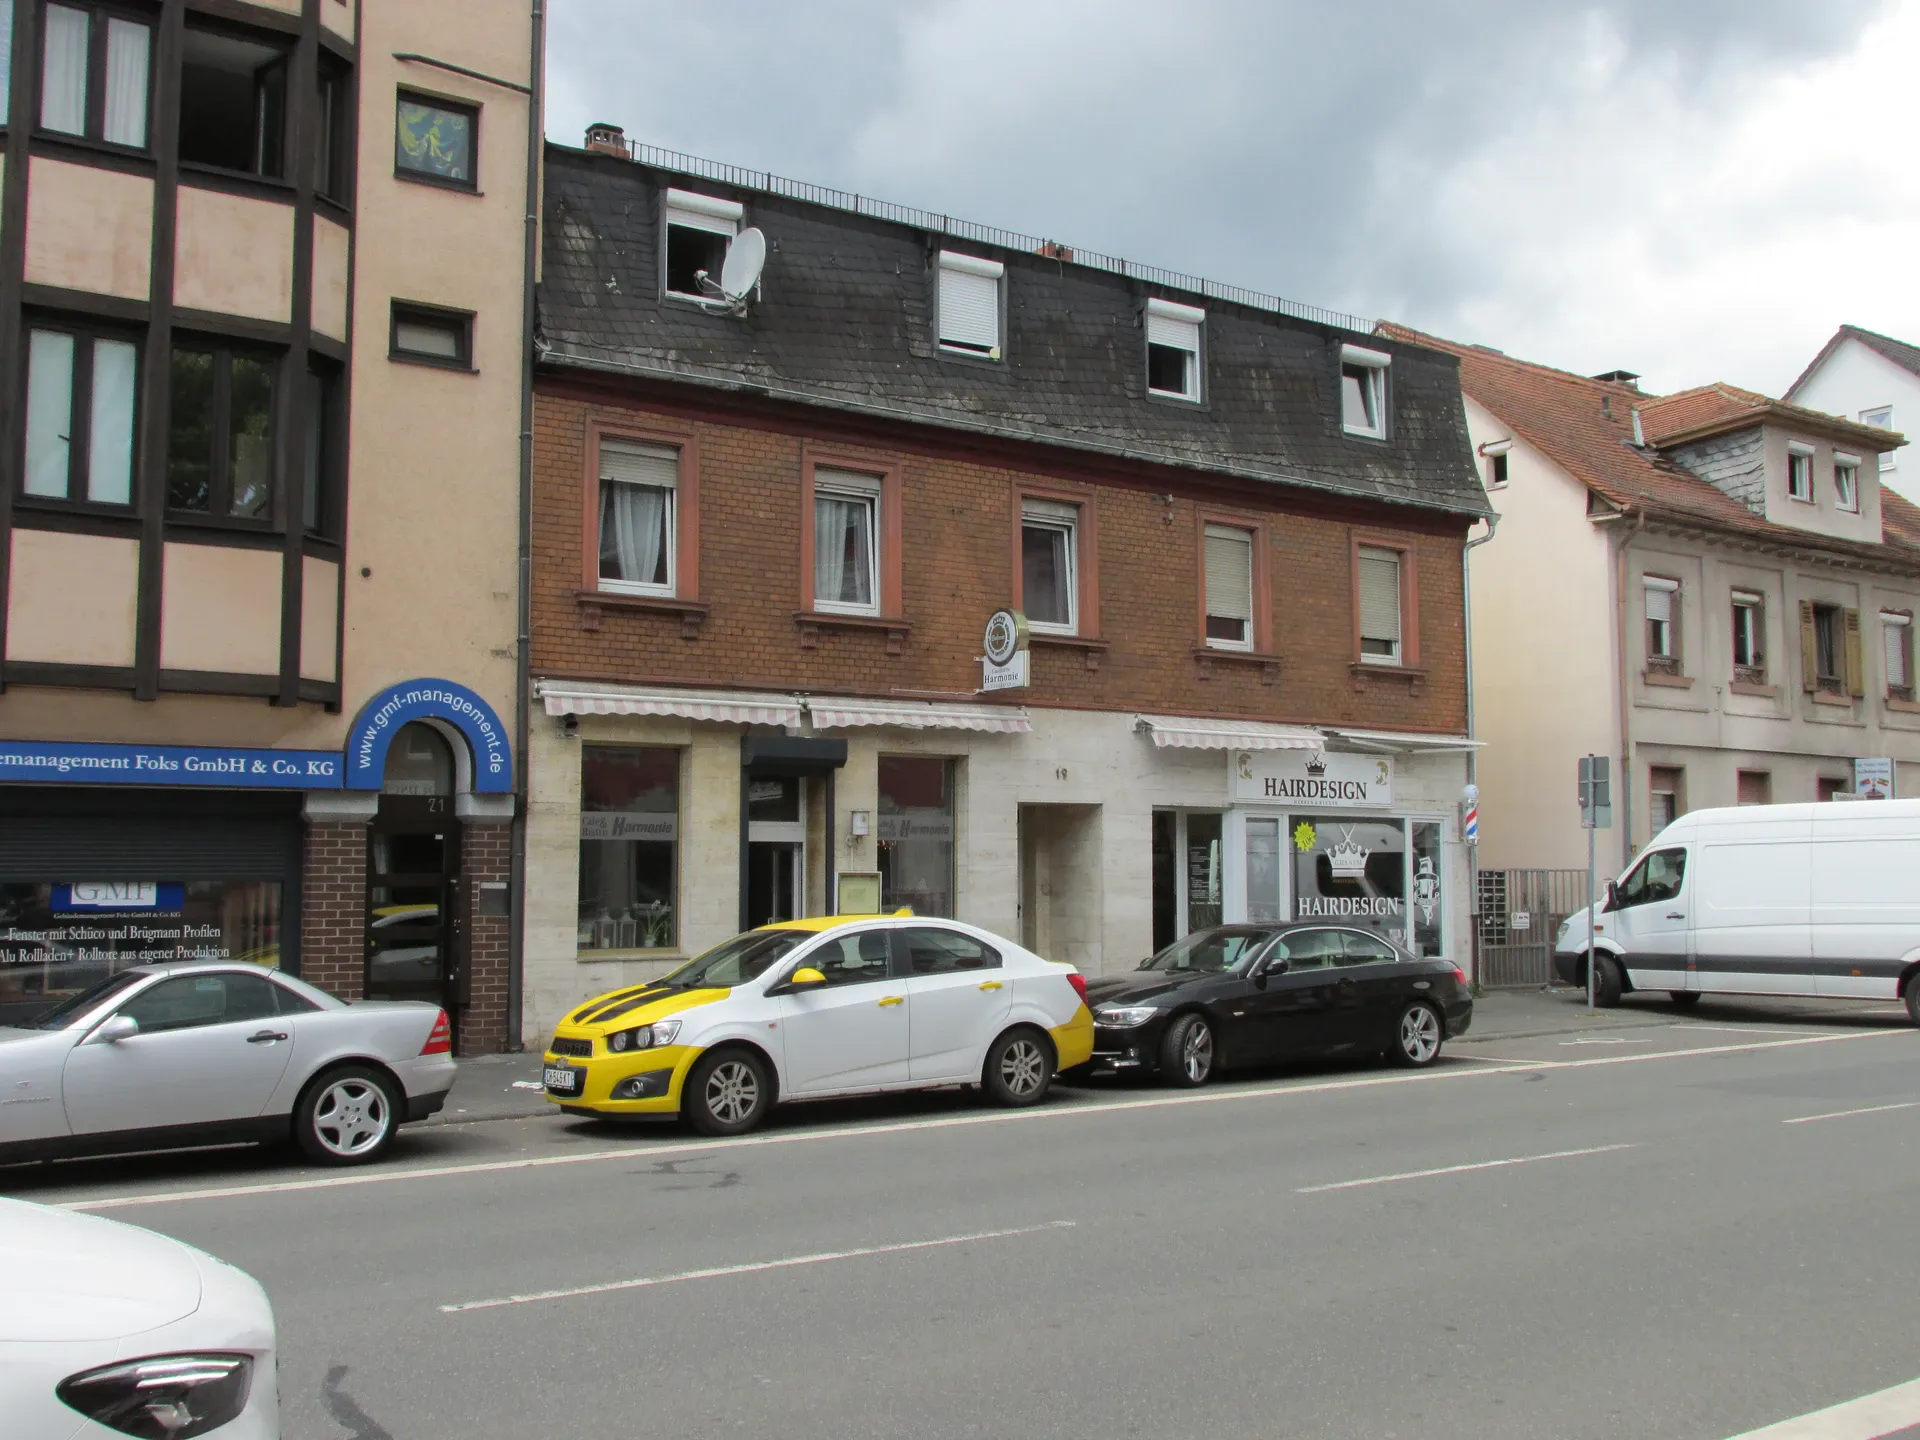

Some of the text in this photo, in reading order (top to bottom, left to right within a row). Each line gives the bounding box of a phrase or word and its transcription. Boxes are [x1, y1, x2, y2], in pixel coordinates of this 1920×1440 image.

[984, 671, 1018, 683] Harmonie
[359, 689, 504, 773] www.gmf-management.de
[134, 754, 179, 771] Foks
[184, 756, 247, 773] GmbH
[251, 759, 268, 774] &
[272, 760, 301, 775] Co.
[306, 760, 335, 776] KG
[1264, 777, 1368, 800] HAIRDESIGN
[428, 798, 445, 812] 21
[612, 816, 674, 837] Harmonie
[1298, 897, 1399, 916] HAIRDESIGN
[49, 926, 67, 940] mit
[69, 926, 105, 940] Schüco
[108, 925, 127, 939] und
[130, 925, 180, 943] Brügmann
[184, 924, 221, 938] Profilen
[0, 948, 16, 962] Alu
[79, 947, 118, 961] Rolltore
[120, 950, 137, 960] aus
[139, 946, 175, 963] eigener
[177, 944, 230, 959] Produktion
